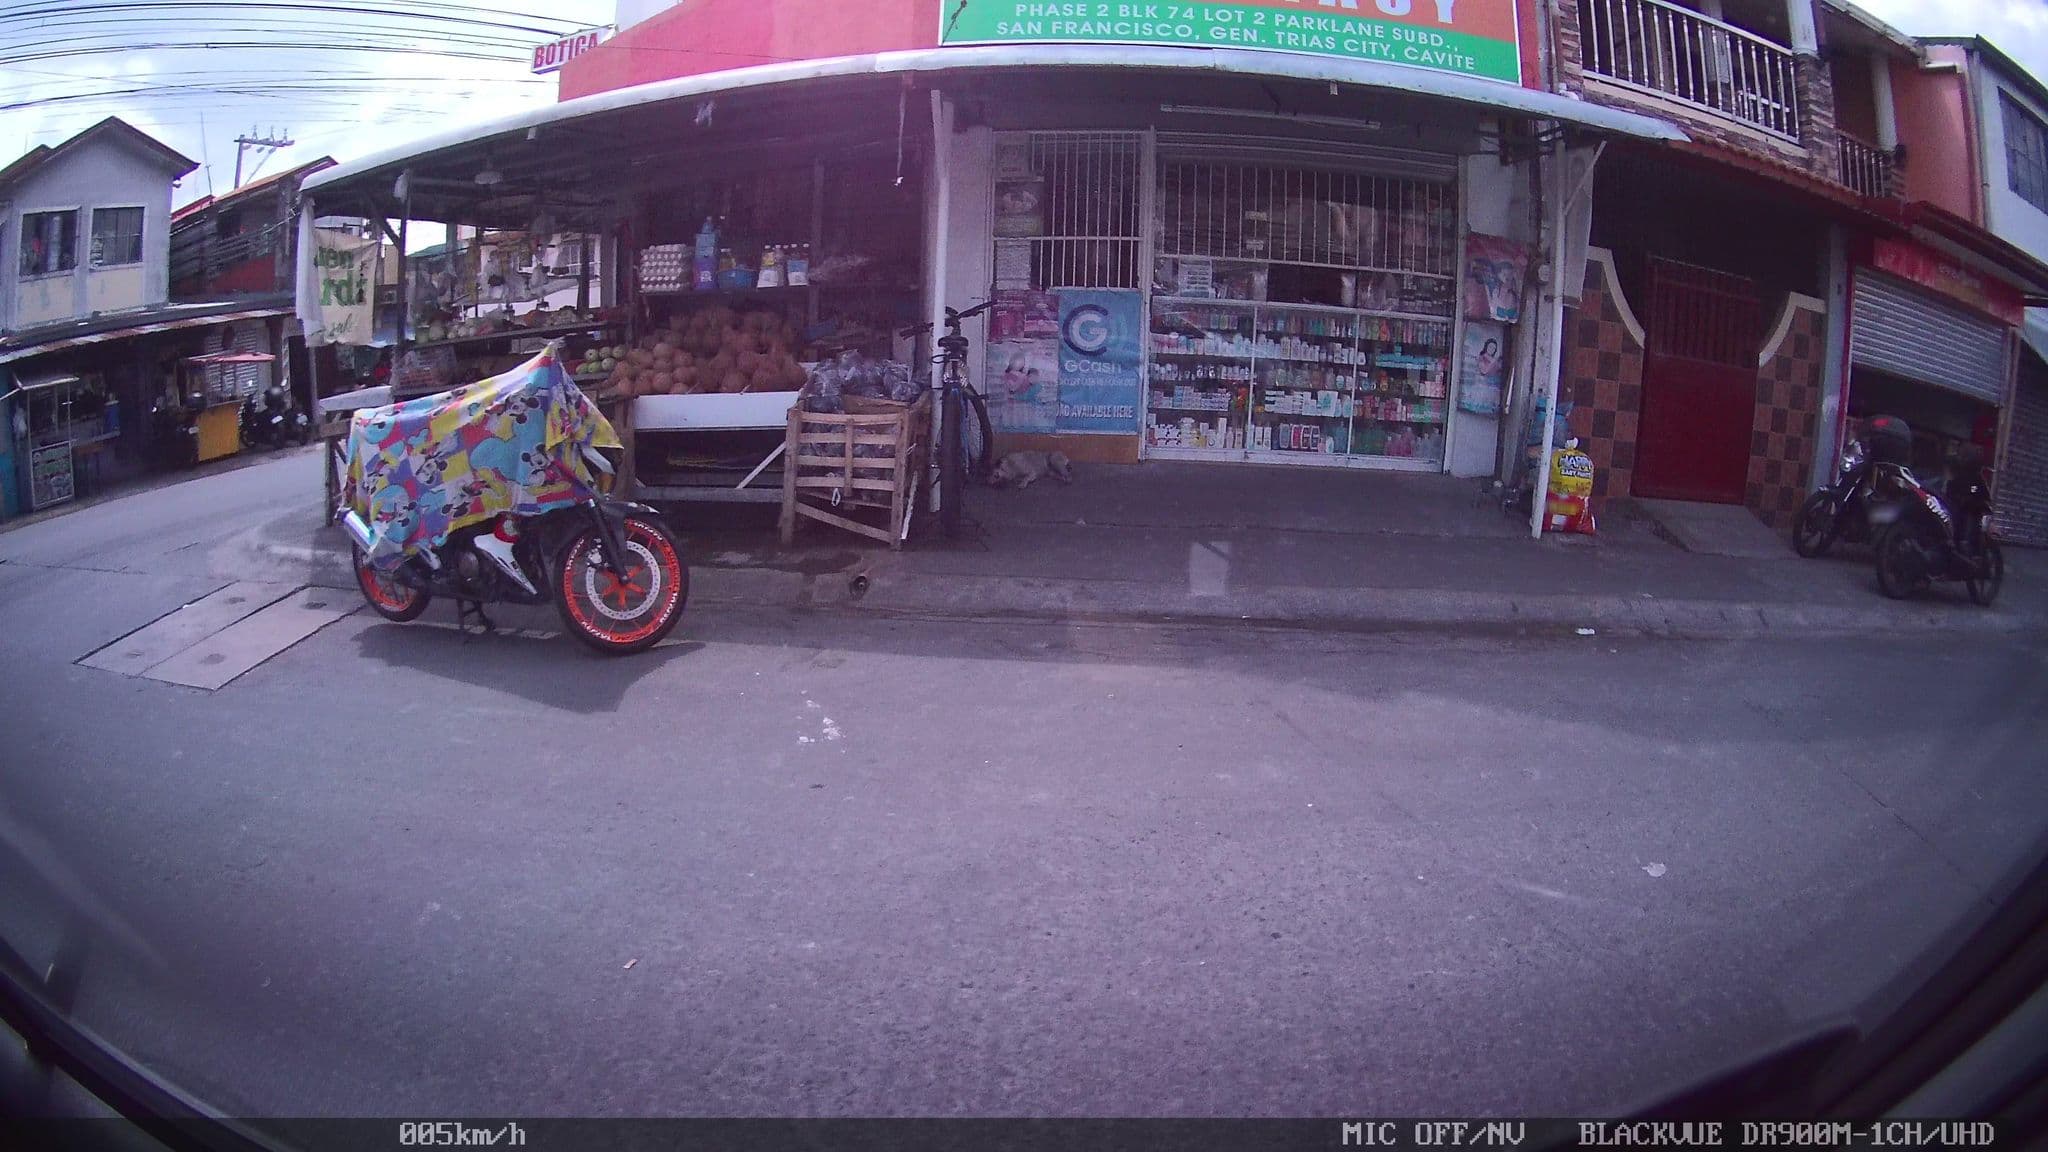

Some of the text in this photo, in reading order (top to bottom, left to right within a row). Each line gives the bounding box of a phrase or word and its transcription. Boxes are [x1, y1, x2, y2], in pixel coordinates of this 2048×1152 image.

[1016, 4, 1087, 17] PHASE
[1097, 4, 1108, 17] 2
[1119, 4, 1158, 18] BLK
[1168, 6, 1195, 20] 74
[1204, 8, 1246, 23] LOT
[1254, 12, 1266, 25] 2
[1275, 13, 1385, 38] PARKLANE
[534, 32, 598, 68] BOTICA
[996, 21, 1475, 70] SAN FRANCISCO, GEN. TRIAS CITY, CAVITE
[1064, 359, 1122, 373] GCash
[1113, 405, 1134, 418] HERE
